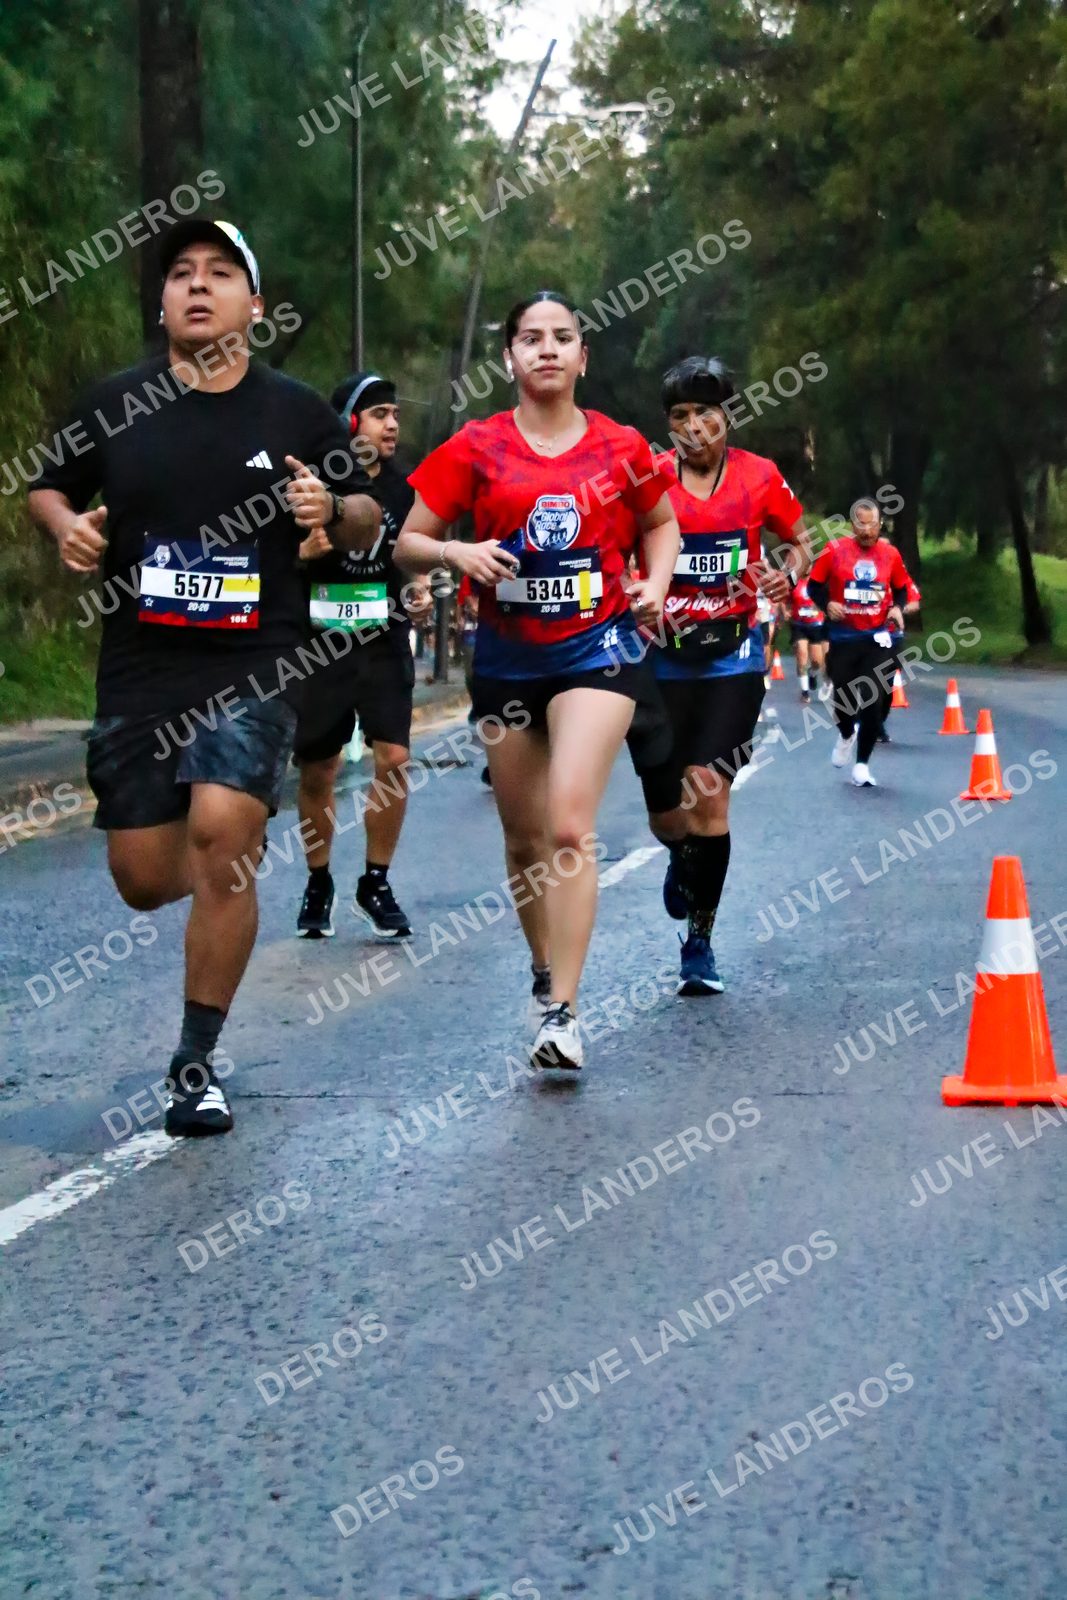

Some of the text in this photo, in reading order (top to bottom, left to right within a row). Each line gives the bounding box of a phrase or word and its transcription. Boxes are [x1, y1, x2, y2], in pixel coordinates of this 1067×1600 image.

[535, 520, 557, 530] Race
[541, 512, 569, 522] Global
[689, 555, 725, 573] 4681
[174, 573, 224, 599] 5577
[527, 579, 574, 601] 5344
[337, 604, 360, 618] 781
